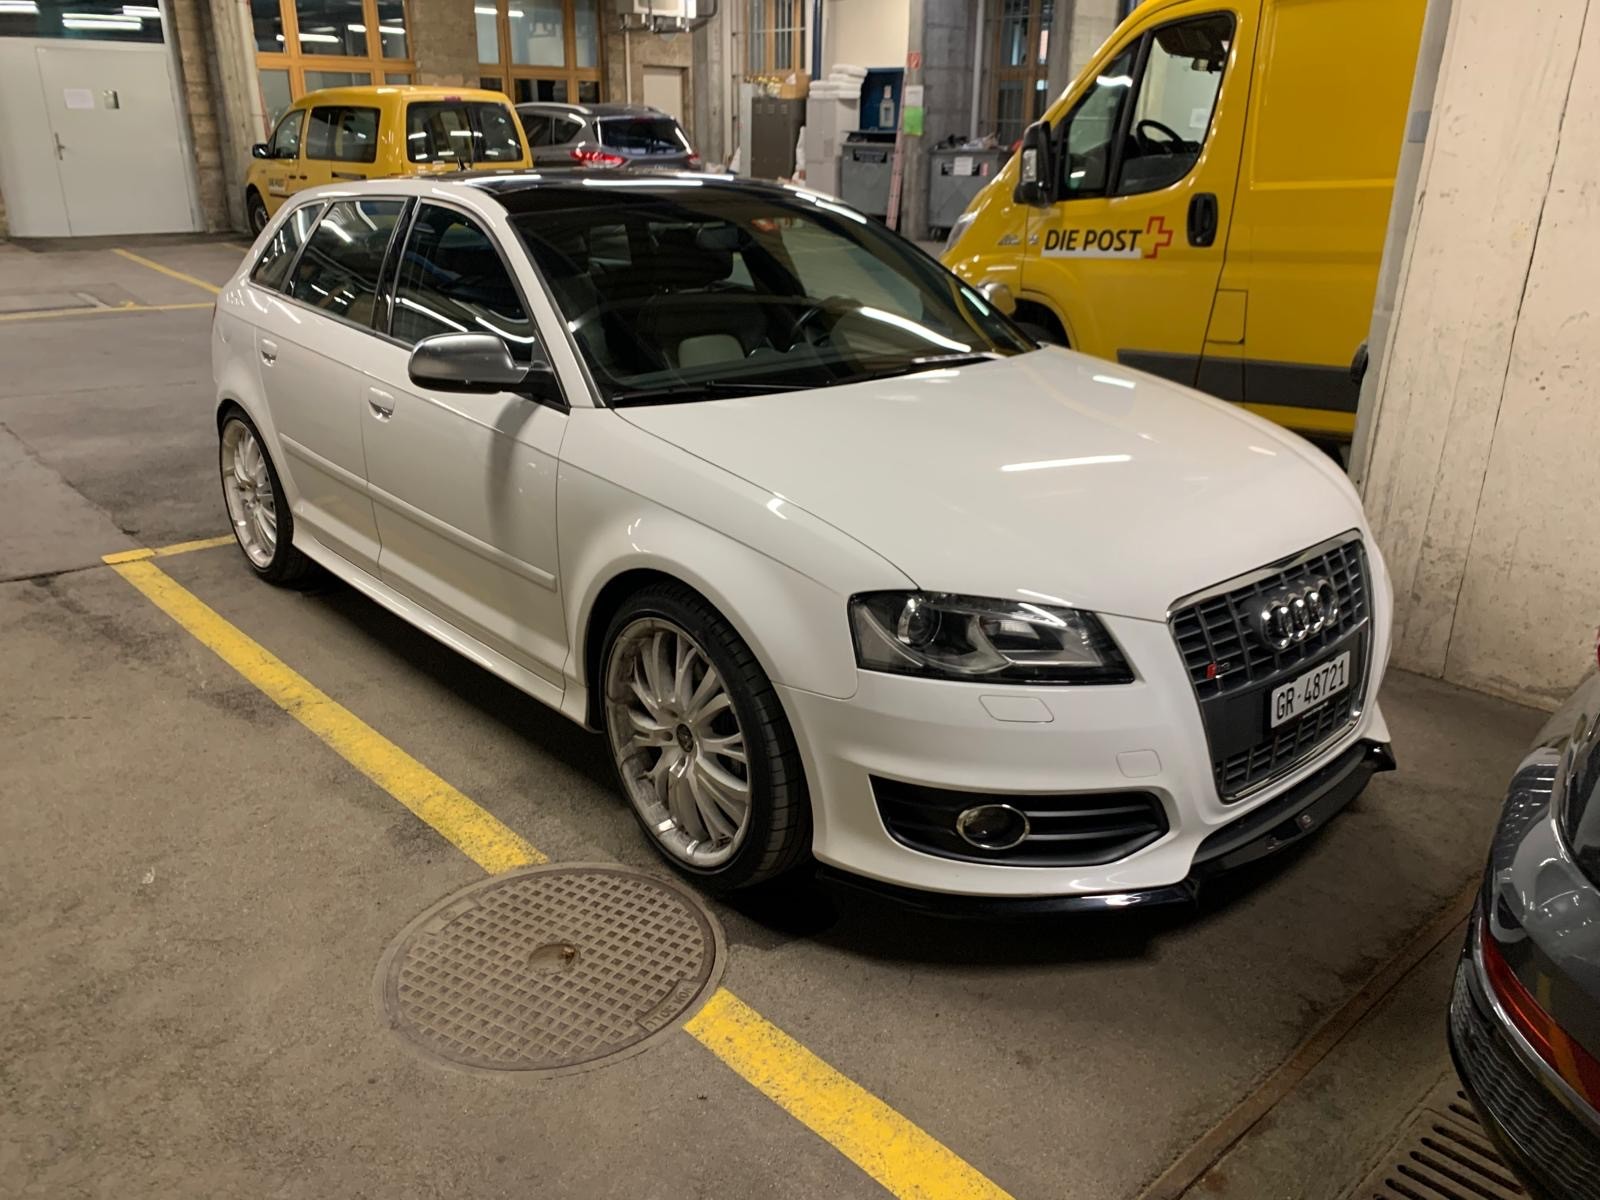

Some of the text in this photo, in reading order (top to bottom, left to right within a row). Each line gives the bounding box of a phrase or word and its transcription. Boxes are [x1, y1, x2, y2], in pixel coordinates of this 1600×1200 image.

[1044, 229, 1079, 251] DIE
[1082, 229, 1143, 252] POST
[1303, 660, 1344, 704] 48721
